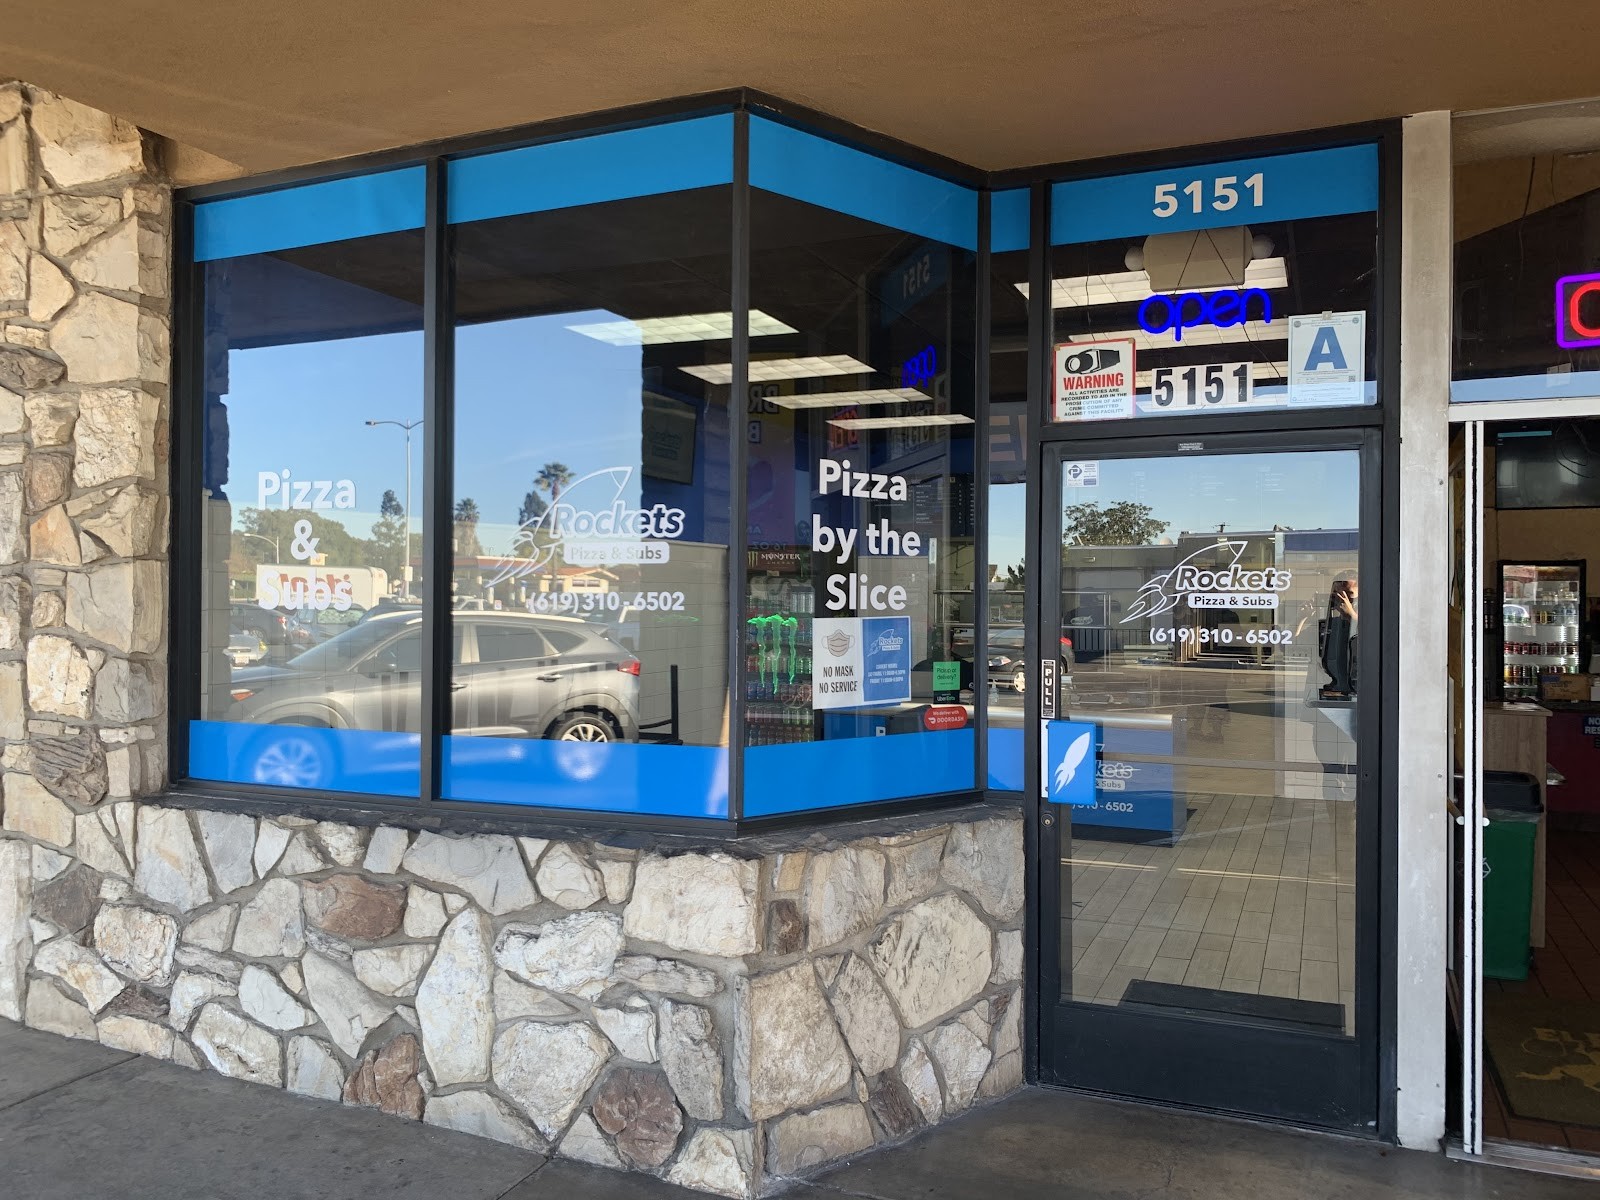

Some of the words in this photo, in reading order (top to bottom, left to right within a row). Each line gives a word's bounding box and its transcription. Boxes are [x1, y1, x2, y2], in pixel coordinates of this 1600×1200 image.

[1152, 172, 1265, 218] 5151
[1137, 287, 1273, 342] open
[1303, 326, 1348, 371] A
[1063, 373, 1124, 390] WARNING
[1154, 364, 1248, 407] 5151
[258, 469, 356, 512] Pizza
[818, 458, 908, 502] Pizza
[551, 500, 686, 539] Rockets
[812, 513, 857, 565] by
[865, 517, 921, 557] the
[289, 519, 320, 562] &
[569, 546, 607, 563] Pizza
[610, 546, 623, 562] &
[625, 547, 663, 563] Subs
[760, 551, 802, 561] MONSTER
[258, 566, 353, 612] Subs
[825, 571, 908, 611] Slice
[1176, 564, 1292, 592] Rockets
[529, 591, 580, 615] (619)
[1193, 595, 1226, 608] Pizza
[1228, 595, 1239, 607] &
[1241, 594, 1274, 608] Subs
[1149, 627, 1196, 646] (619)
[819, 683, 829, 693] NO
[831, 681, 858, 693] SERVICE
[823, 667, 833, 678] NO
[834, 665, 854, 676] MASK
[1044, 667, 1053, 707] PULL
[1095, 760, 1133, 779] kets
[1101, 780, 1122, 789] Subs
